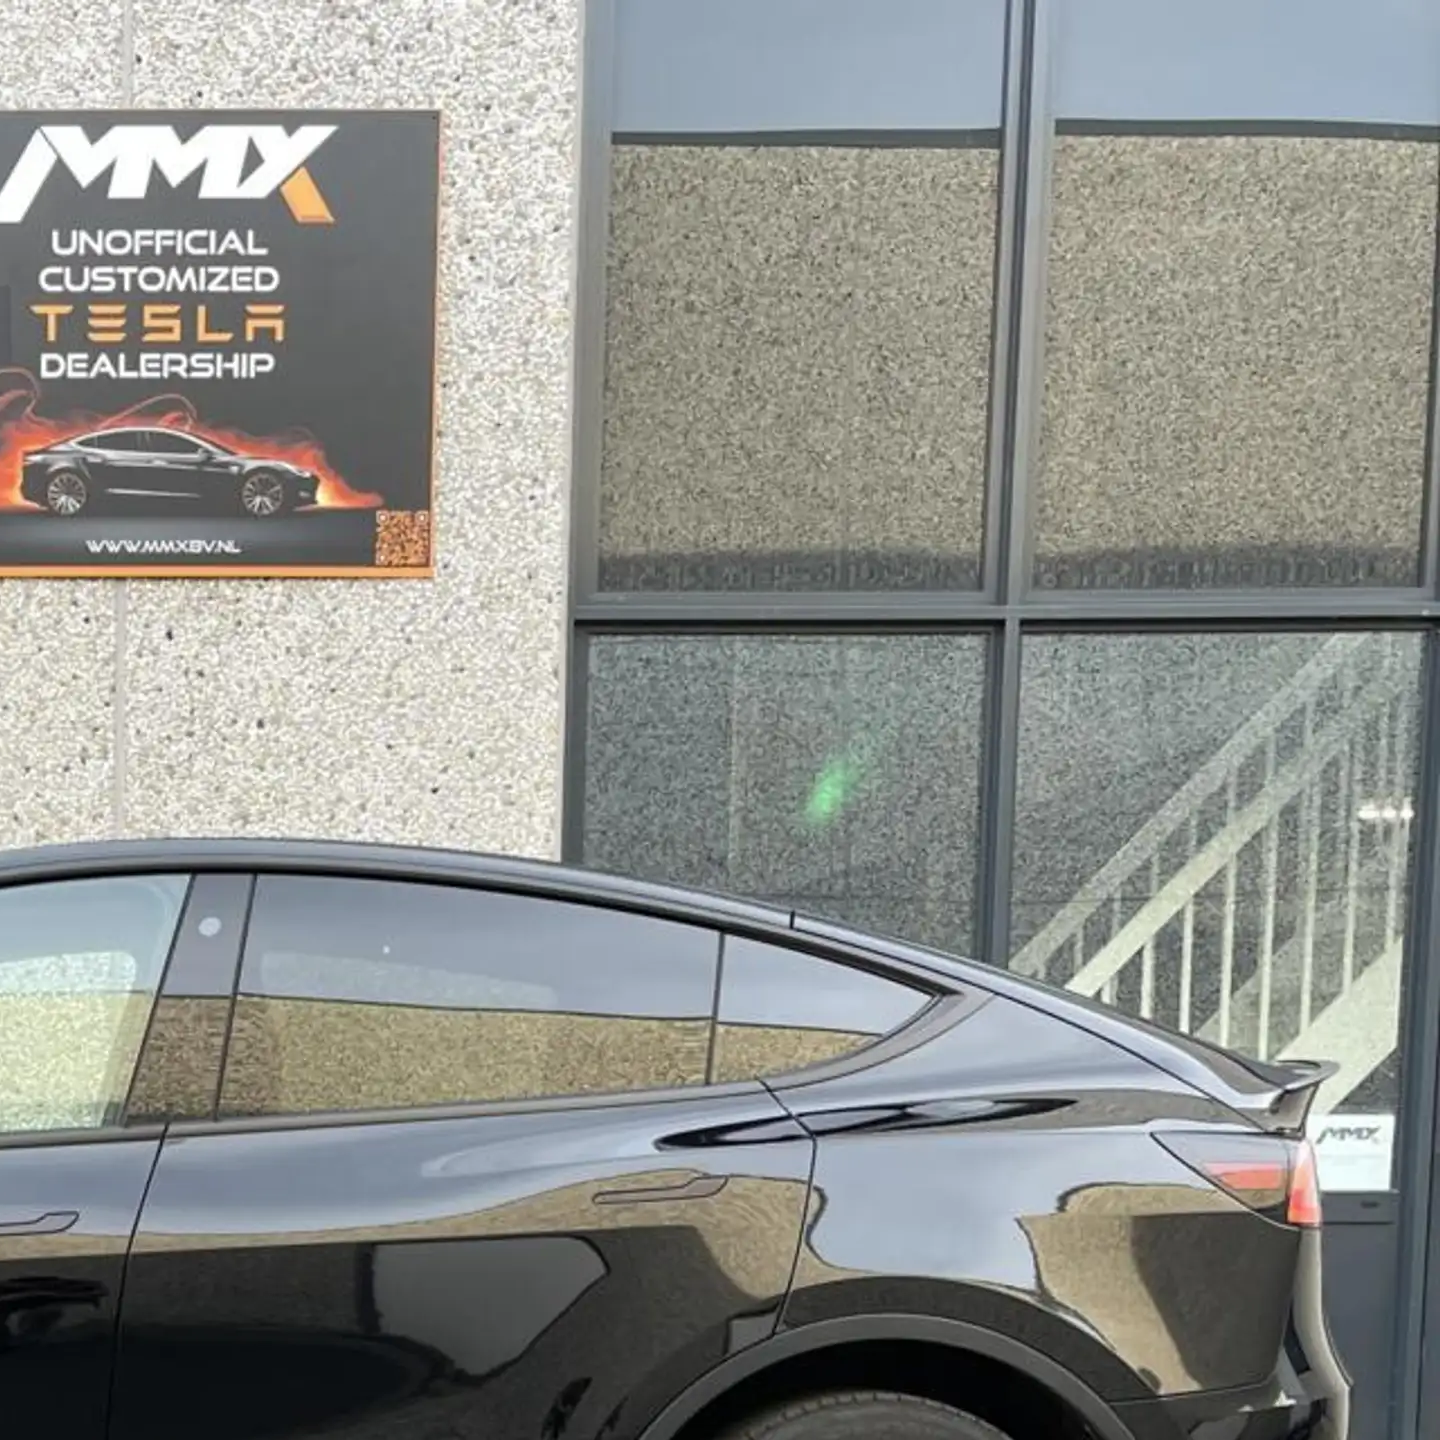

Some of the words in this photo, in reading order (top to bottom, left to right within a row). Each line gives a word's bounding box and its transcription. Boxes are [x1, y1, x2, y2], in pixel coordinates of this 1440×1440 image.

[51, 229, 268, 256] UNOFFICIAL
[38, 266, 280, 293] CUSTOMIZED
[30, 304, 285, 342] TESLA
[40, 353, 276, 379] DEALERSHIP
[85, 539, 242, 554] WWW.MMXBV.NL
